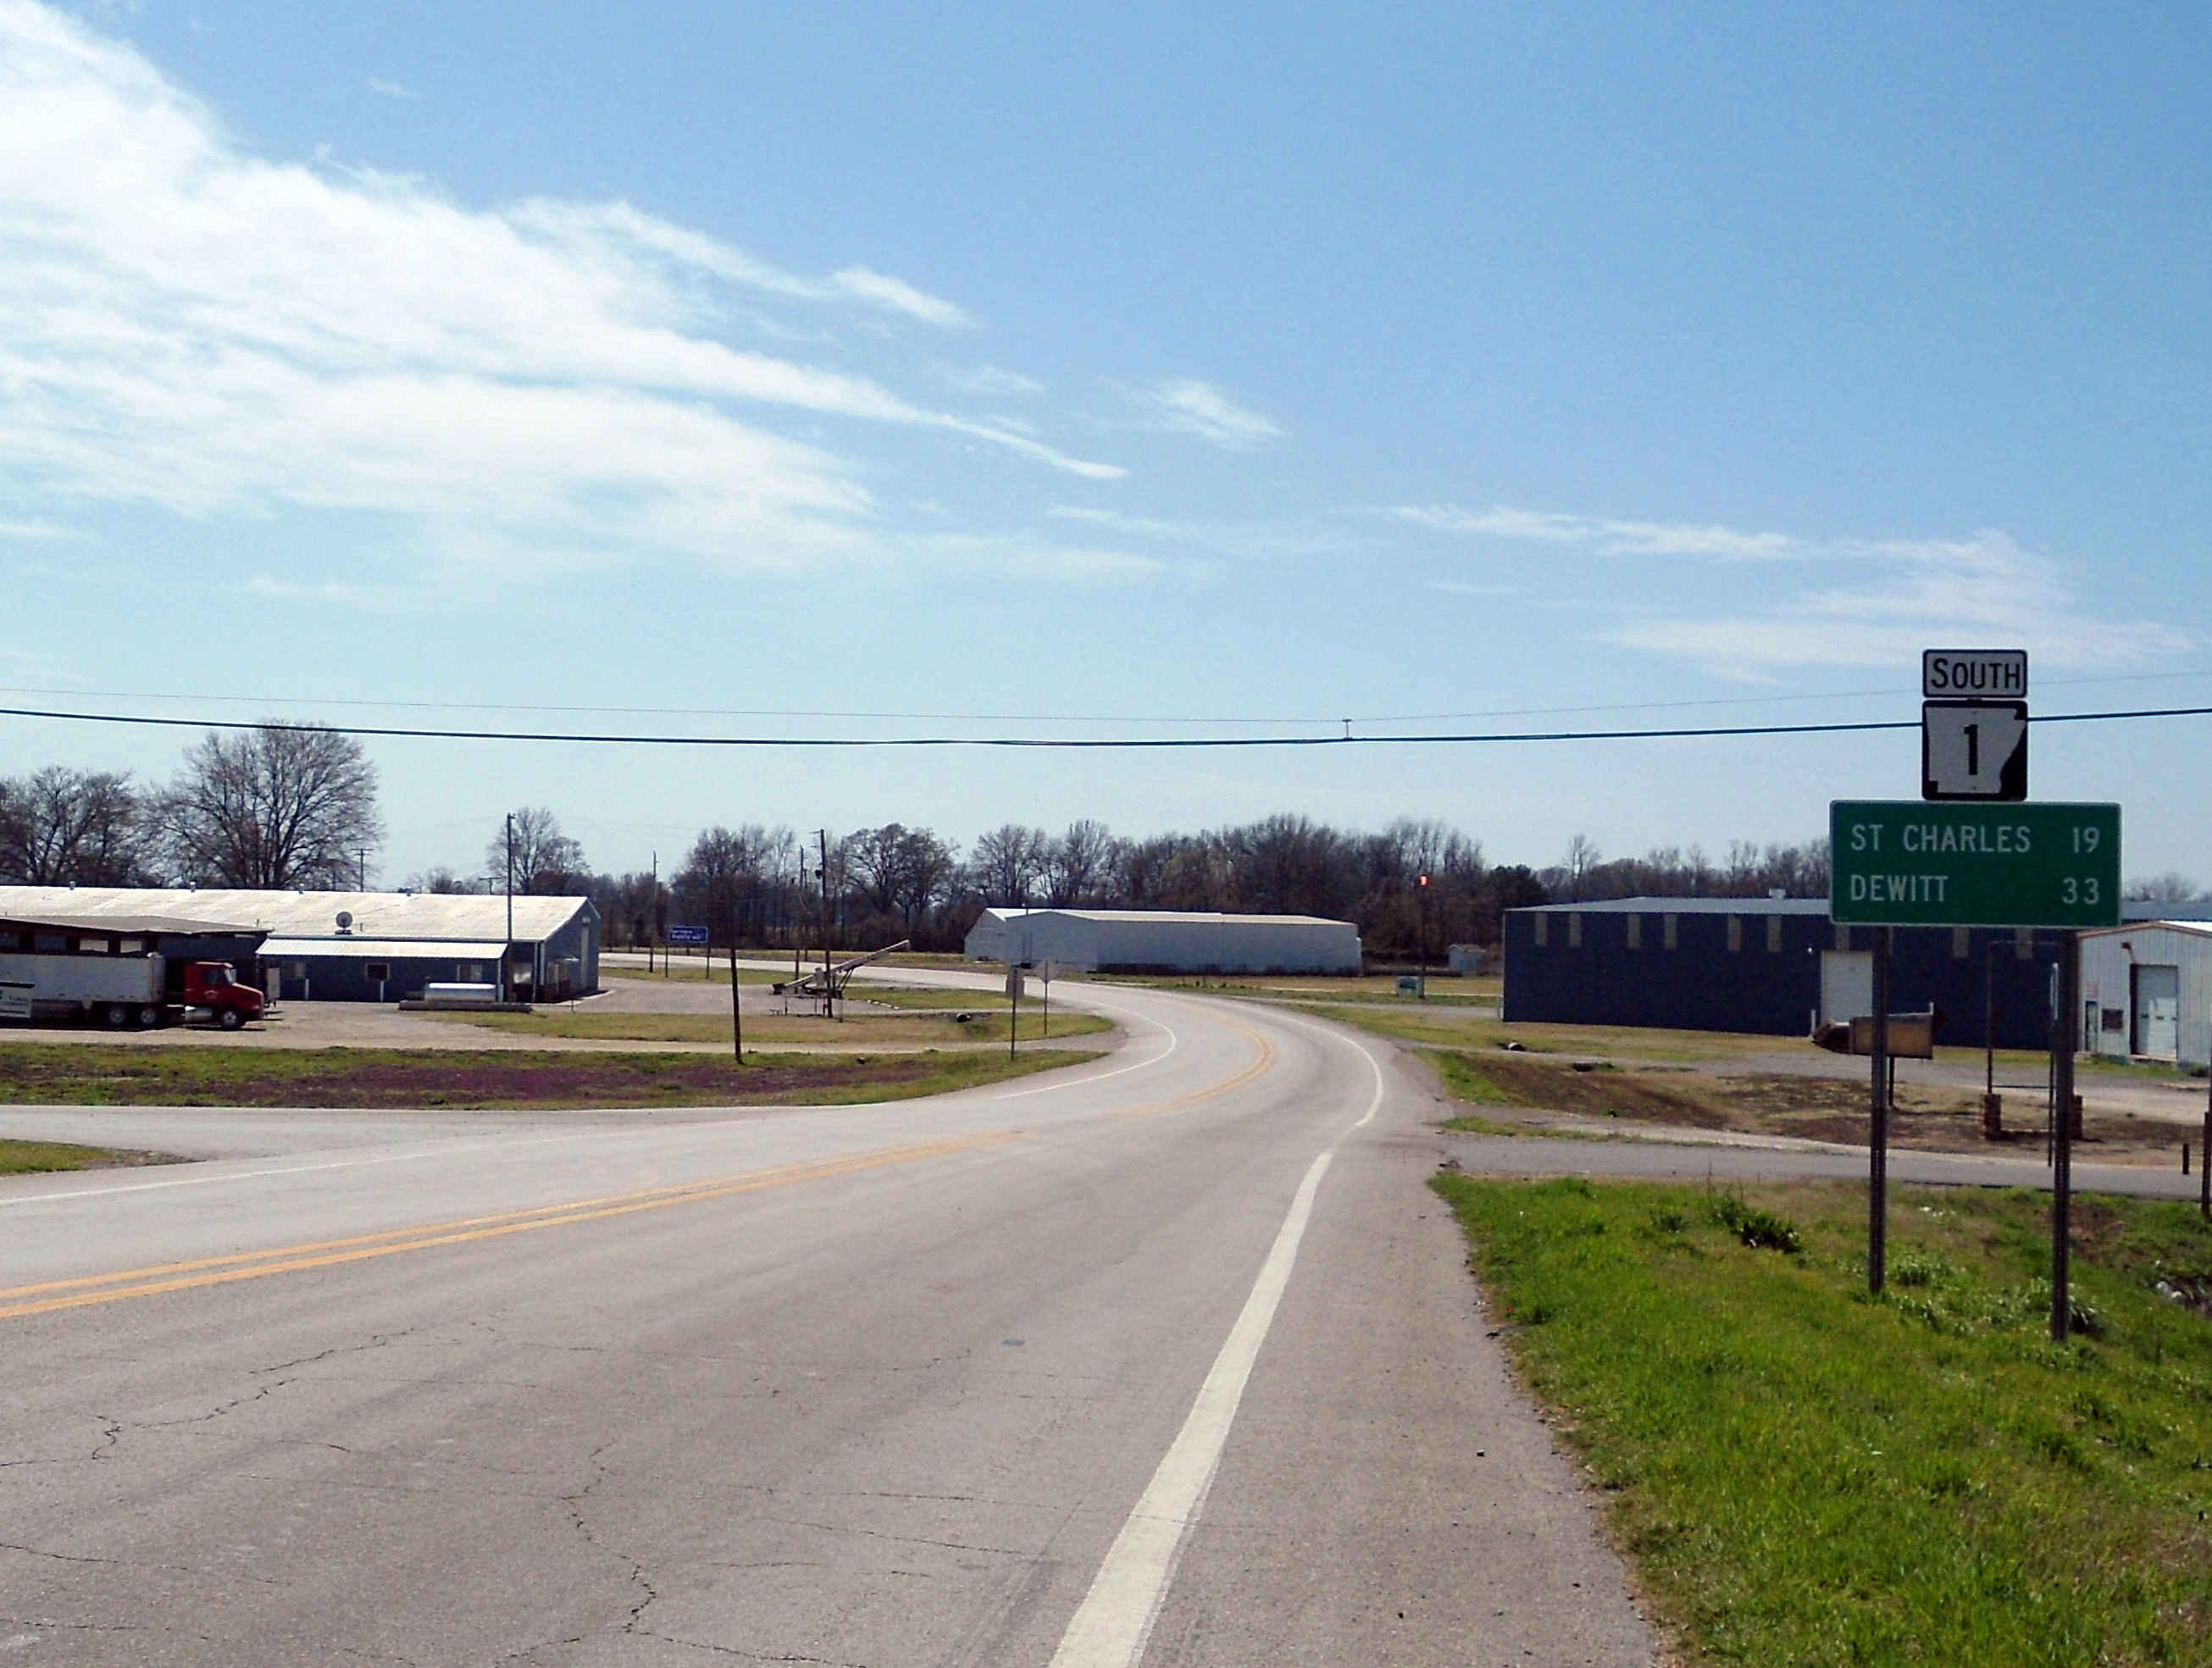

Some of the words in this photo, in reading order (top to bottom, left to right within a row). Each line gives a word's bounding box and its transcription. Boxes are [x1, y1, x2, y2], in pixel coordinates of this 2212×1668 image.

[1931, 657, 2021, 690] SOUTH
[1964, 723, 1978, 775] 1
[1850, 823, 1883, 851] ST
[1902, 824, 2031, 853] CHARLES
[2072, 826, 2100, 853] 19
[1850, 874, 1949, 902] DEWITT
[2062, 877, 2099, 905] 33
